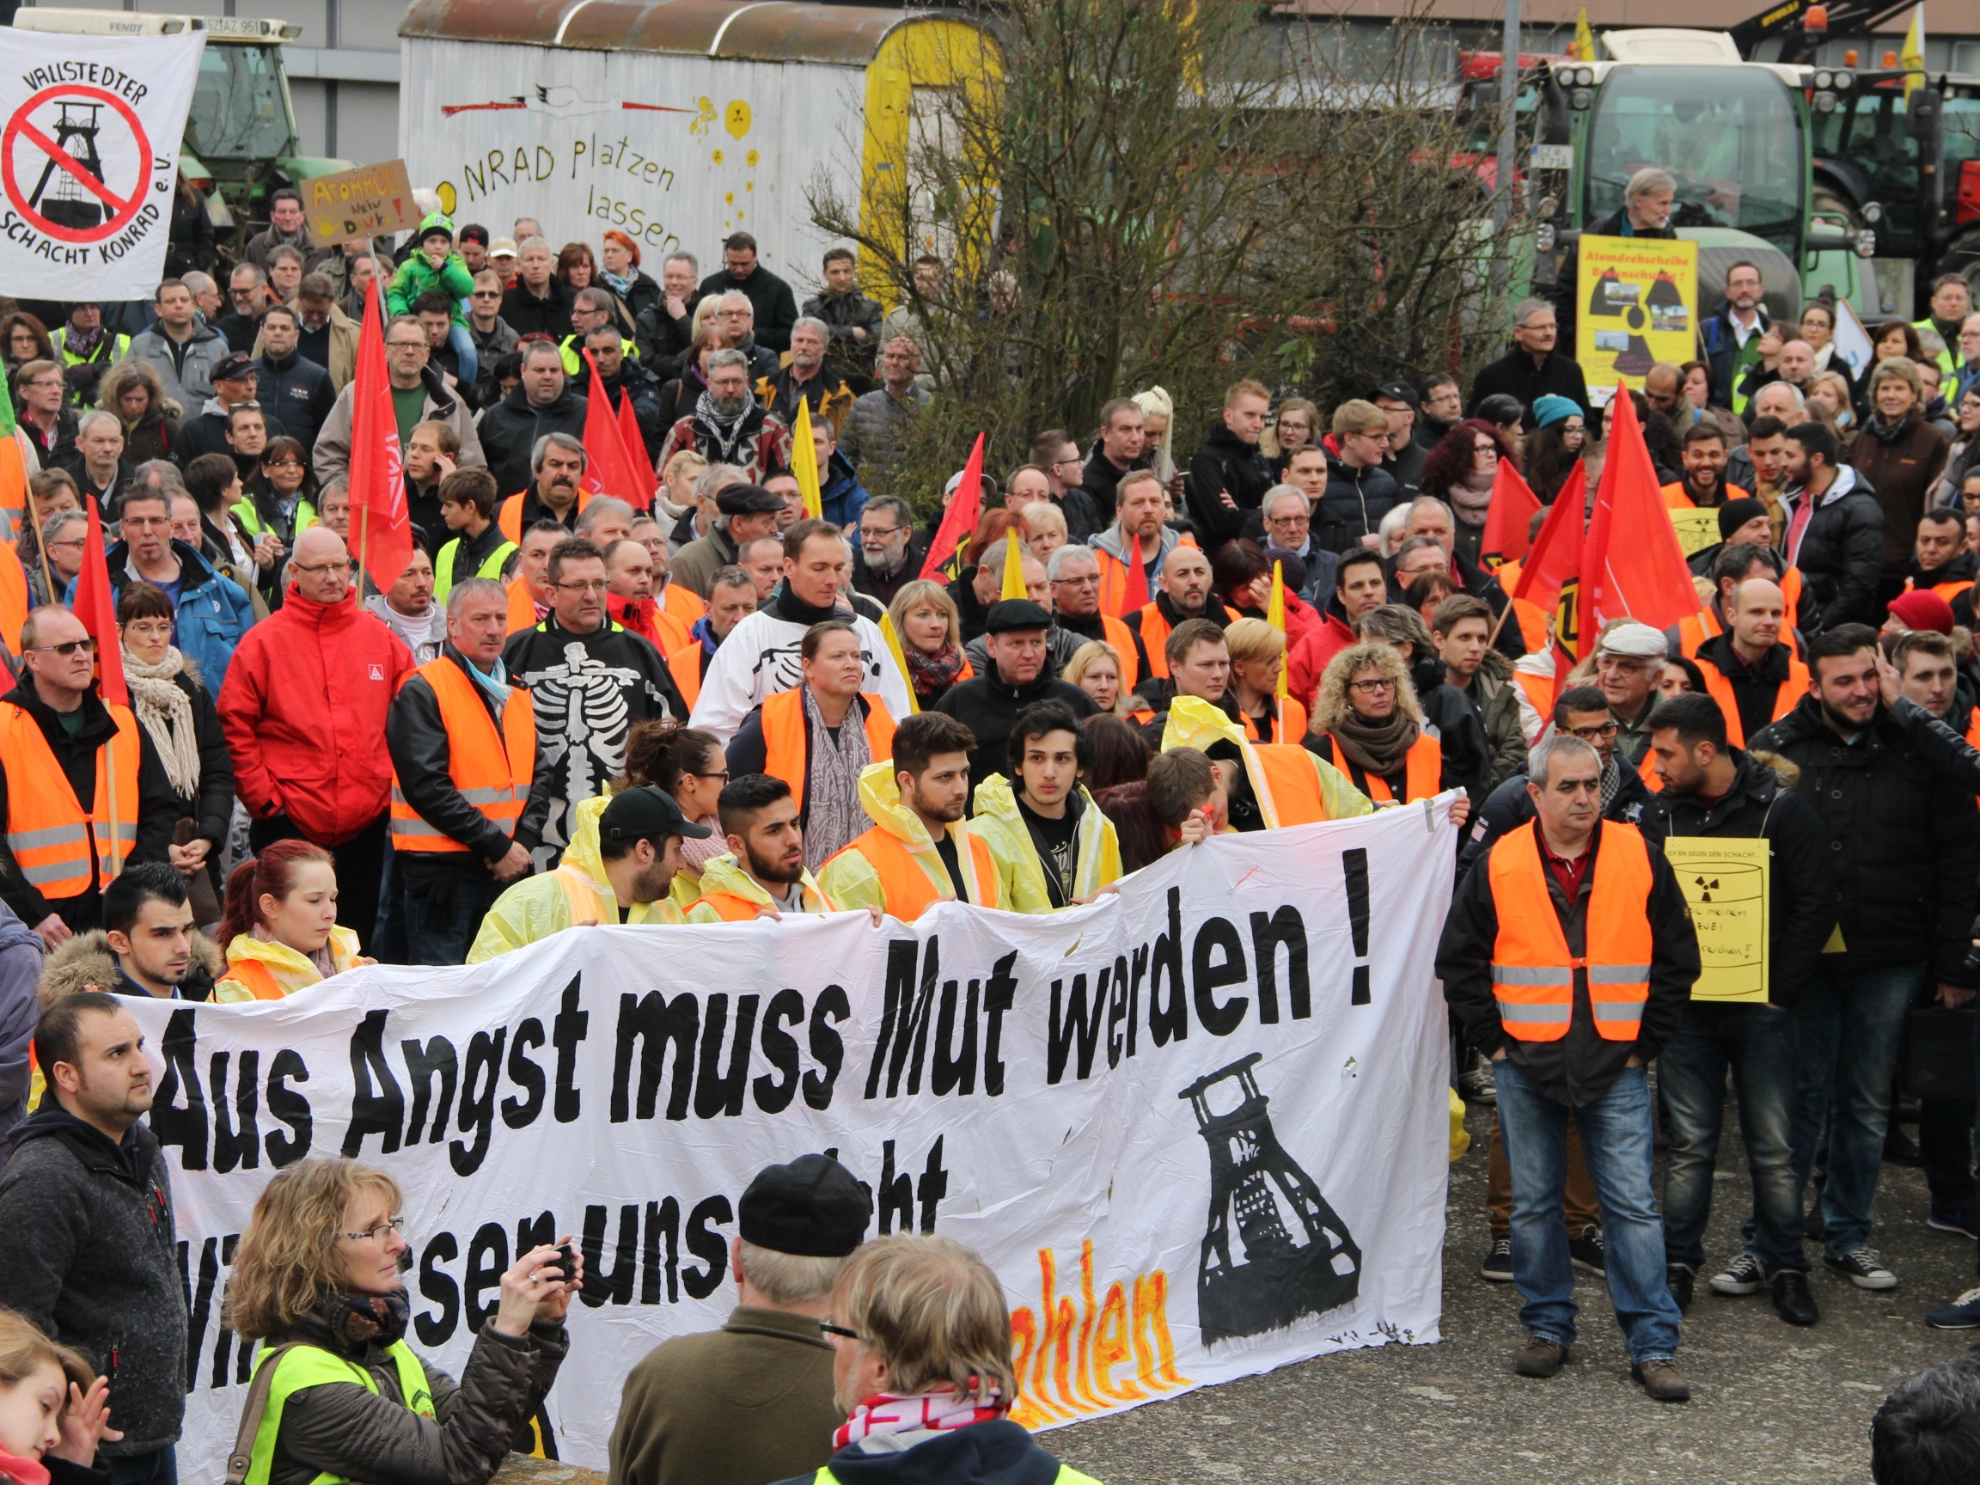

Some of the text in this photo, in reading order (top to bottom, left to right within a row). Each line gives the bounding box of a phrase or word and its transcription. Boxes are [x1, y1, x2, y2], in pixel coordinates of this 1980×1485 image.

[109, 21, 143, 33] FENDT
[207, 18, 259, 32] SZ AZ 951
[22, 60, 148, 106] VALLSTEDTER
[0, 210, 91, 265] SCHACHT
[98, 203, 161, 264] KONRAD
[586, 183, 681, 253] lassen
[1585, 250, 1689, 267] Atomdrehscheibe
[150, 847, 1372, 1178] Aus Angst muss Mut werden !
[578, 1194, 735, 1309] uns
